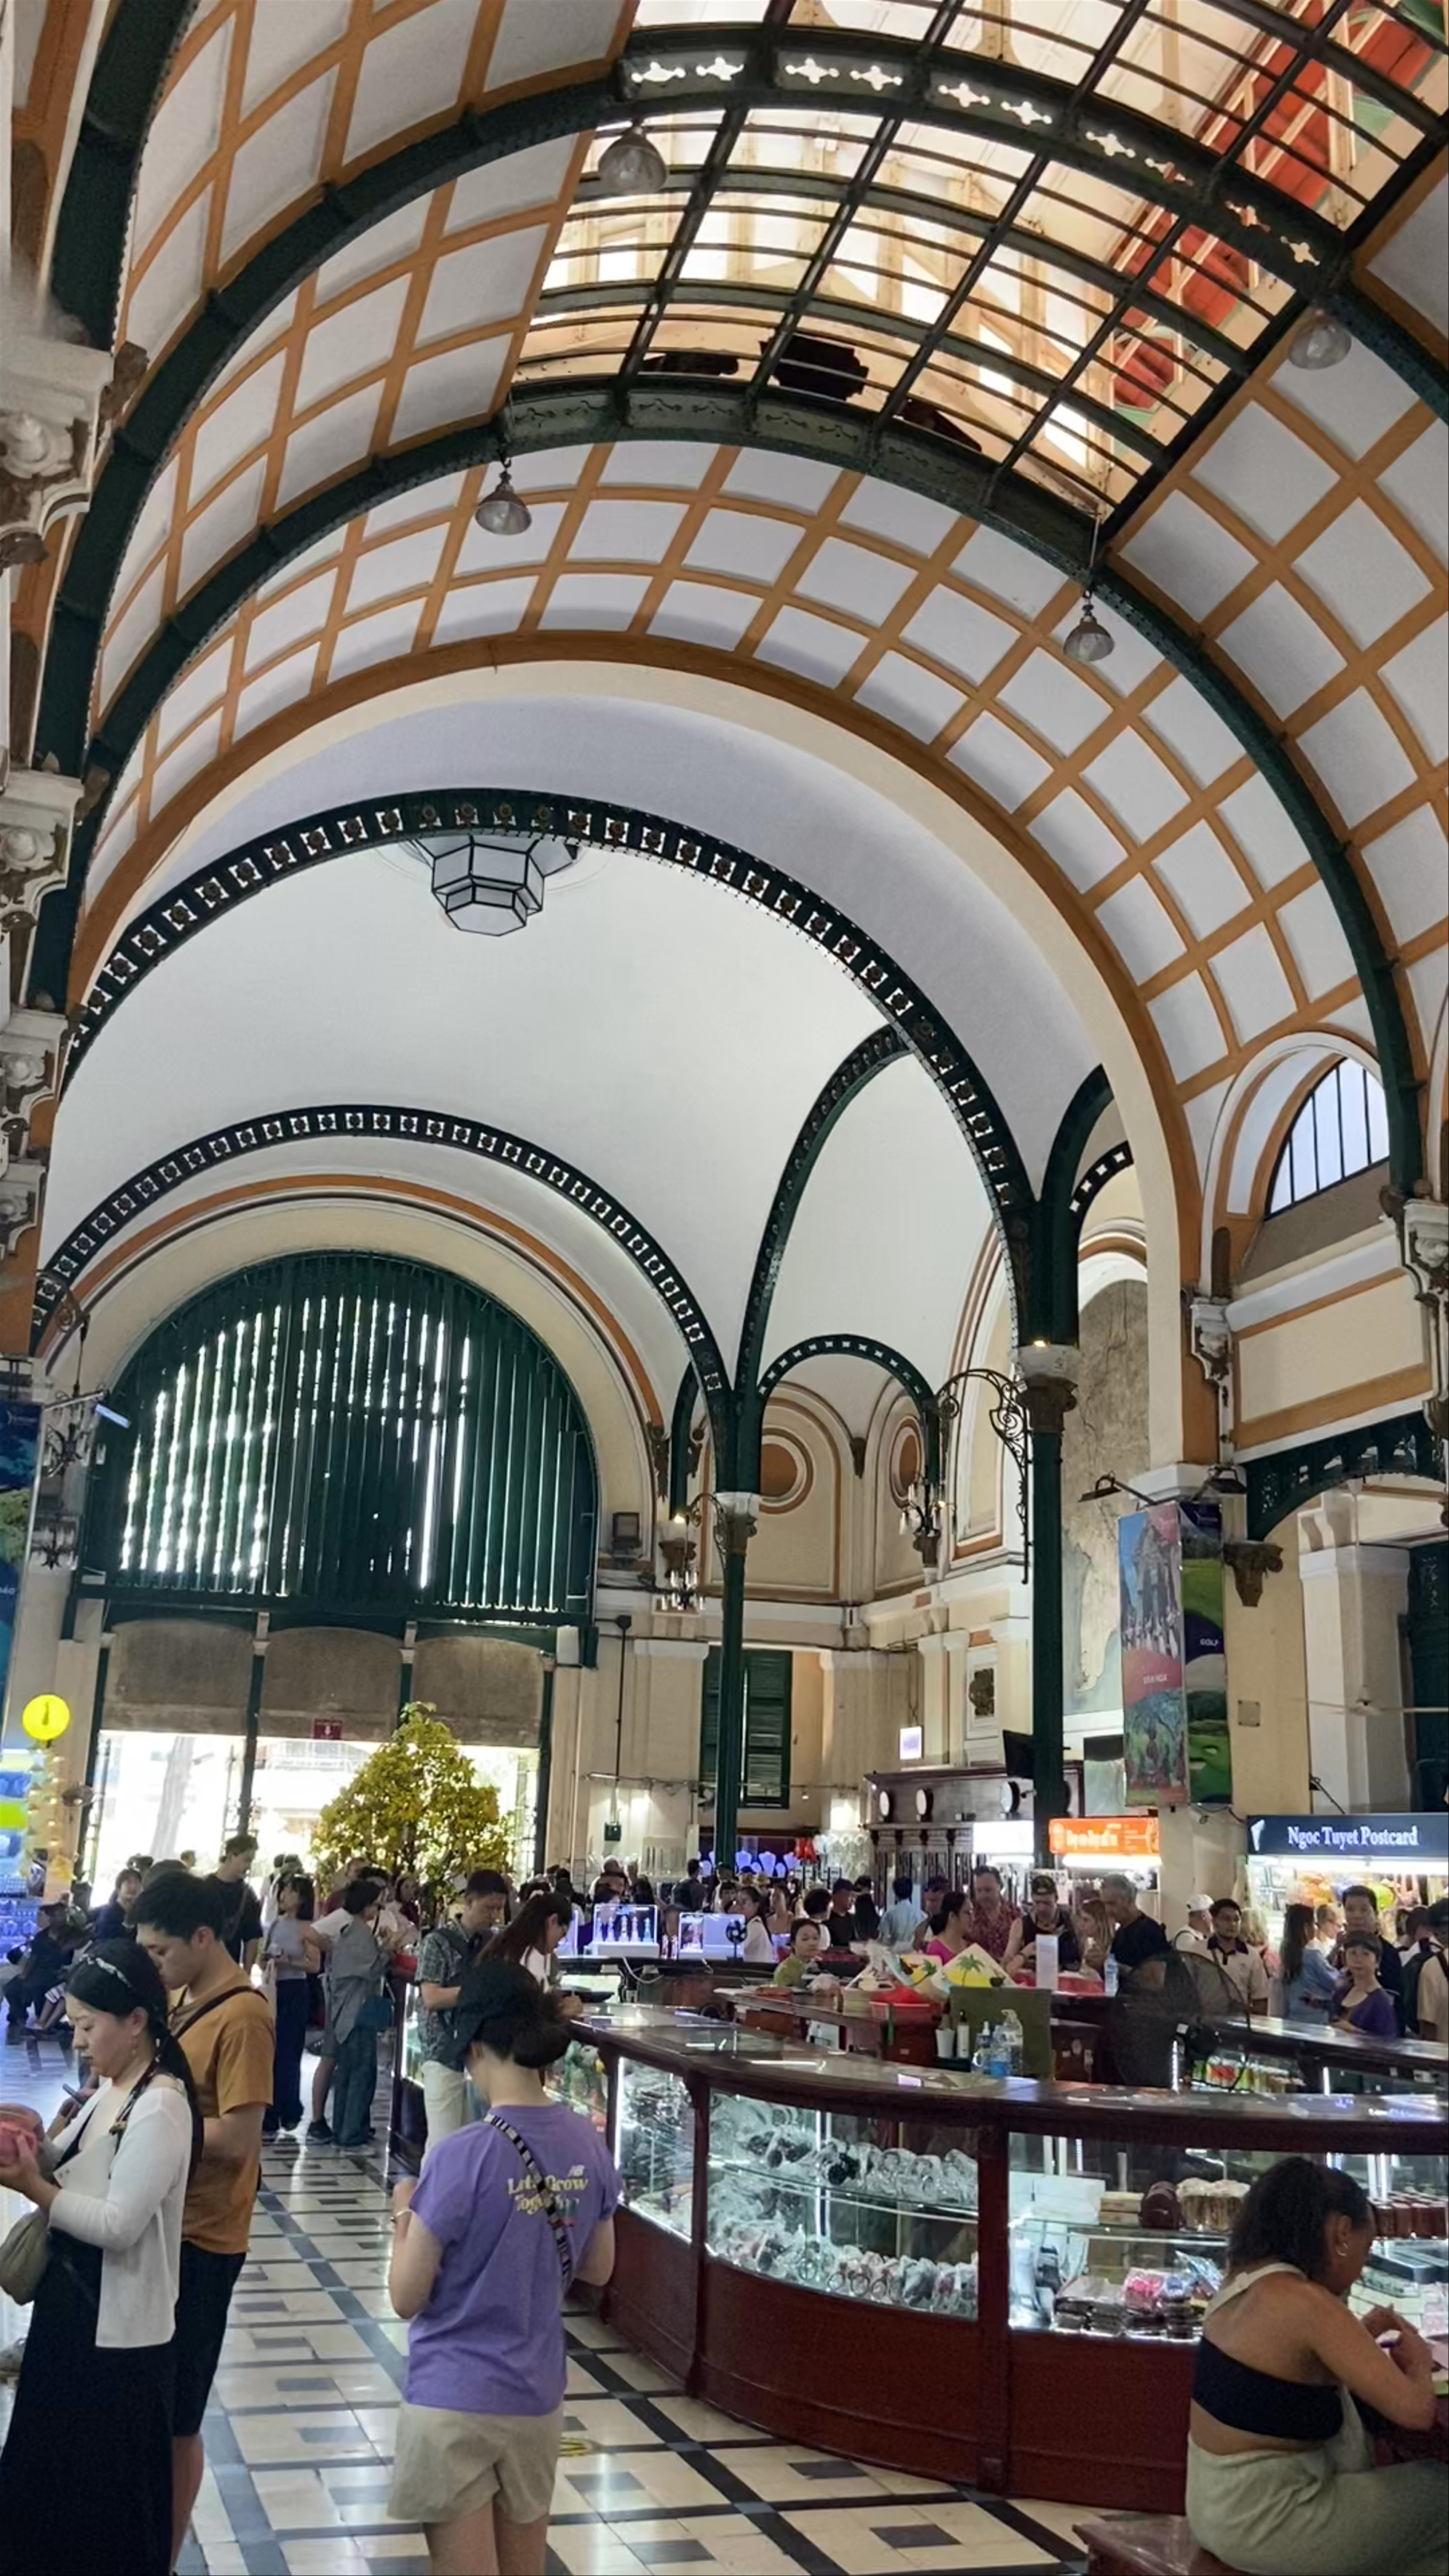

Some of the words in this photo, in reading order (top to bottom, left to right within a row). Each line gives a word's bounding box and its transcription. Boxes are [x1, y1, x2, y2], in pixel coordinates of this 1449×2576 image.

[1287, 1826, 1320, 1849] Ngoc
[1321, 1826, 1359, 1850] Tuyet
[1360, 1825, 1419, 1846] Postcard
[544, 2174, 589, 2191] Grow
